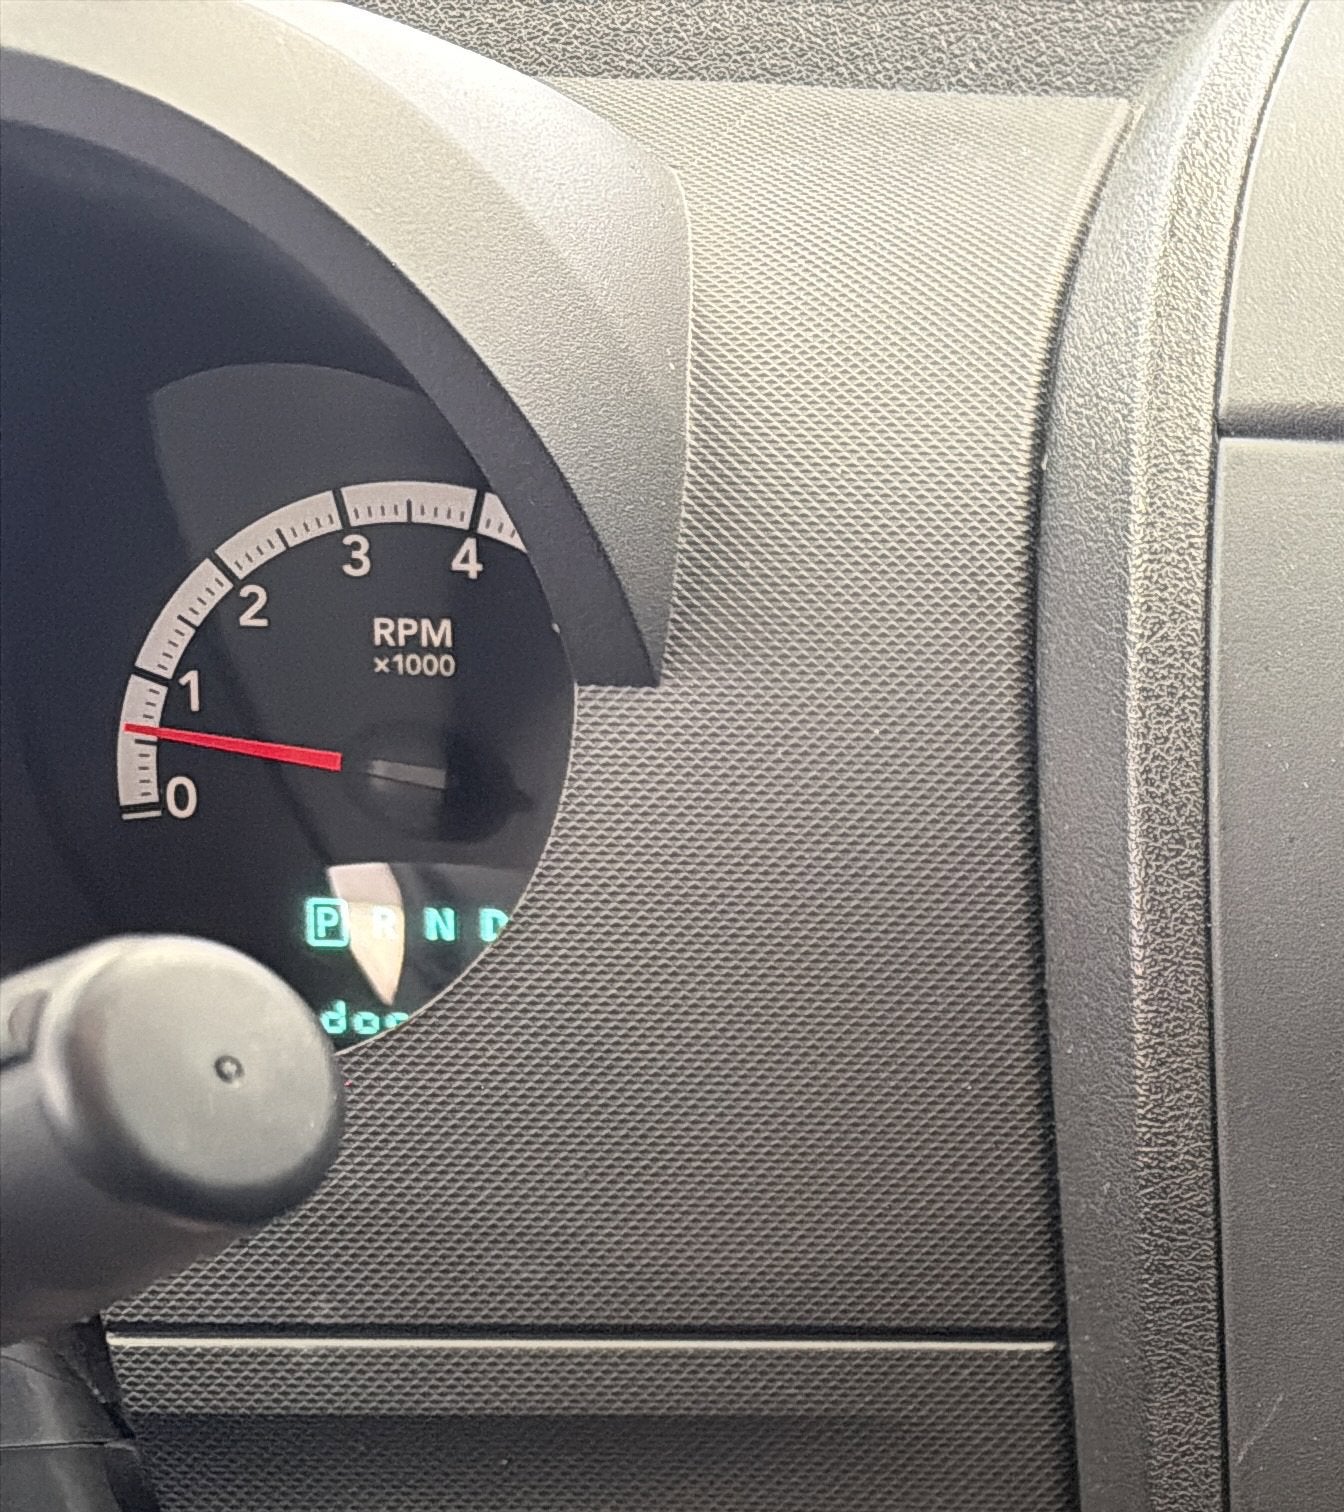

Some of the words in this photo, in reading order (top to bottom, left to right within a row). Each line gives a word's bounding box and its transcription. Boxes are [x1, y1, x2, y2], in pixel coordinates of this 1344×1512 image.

[342, 535, 371, 576] 3
[452, 538, 482, 579] 4
[239, 585, 268, 627] 2
[374, 617, 452, 647] RPM
[179, 670, 200, 711] 1
[166, 775, 197, 818] 0
